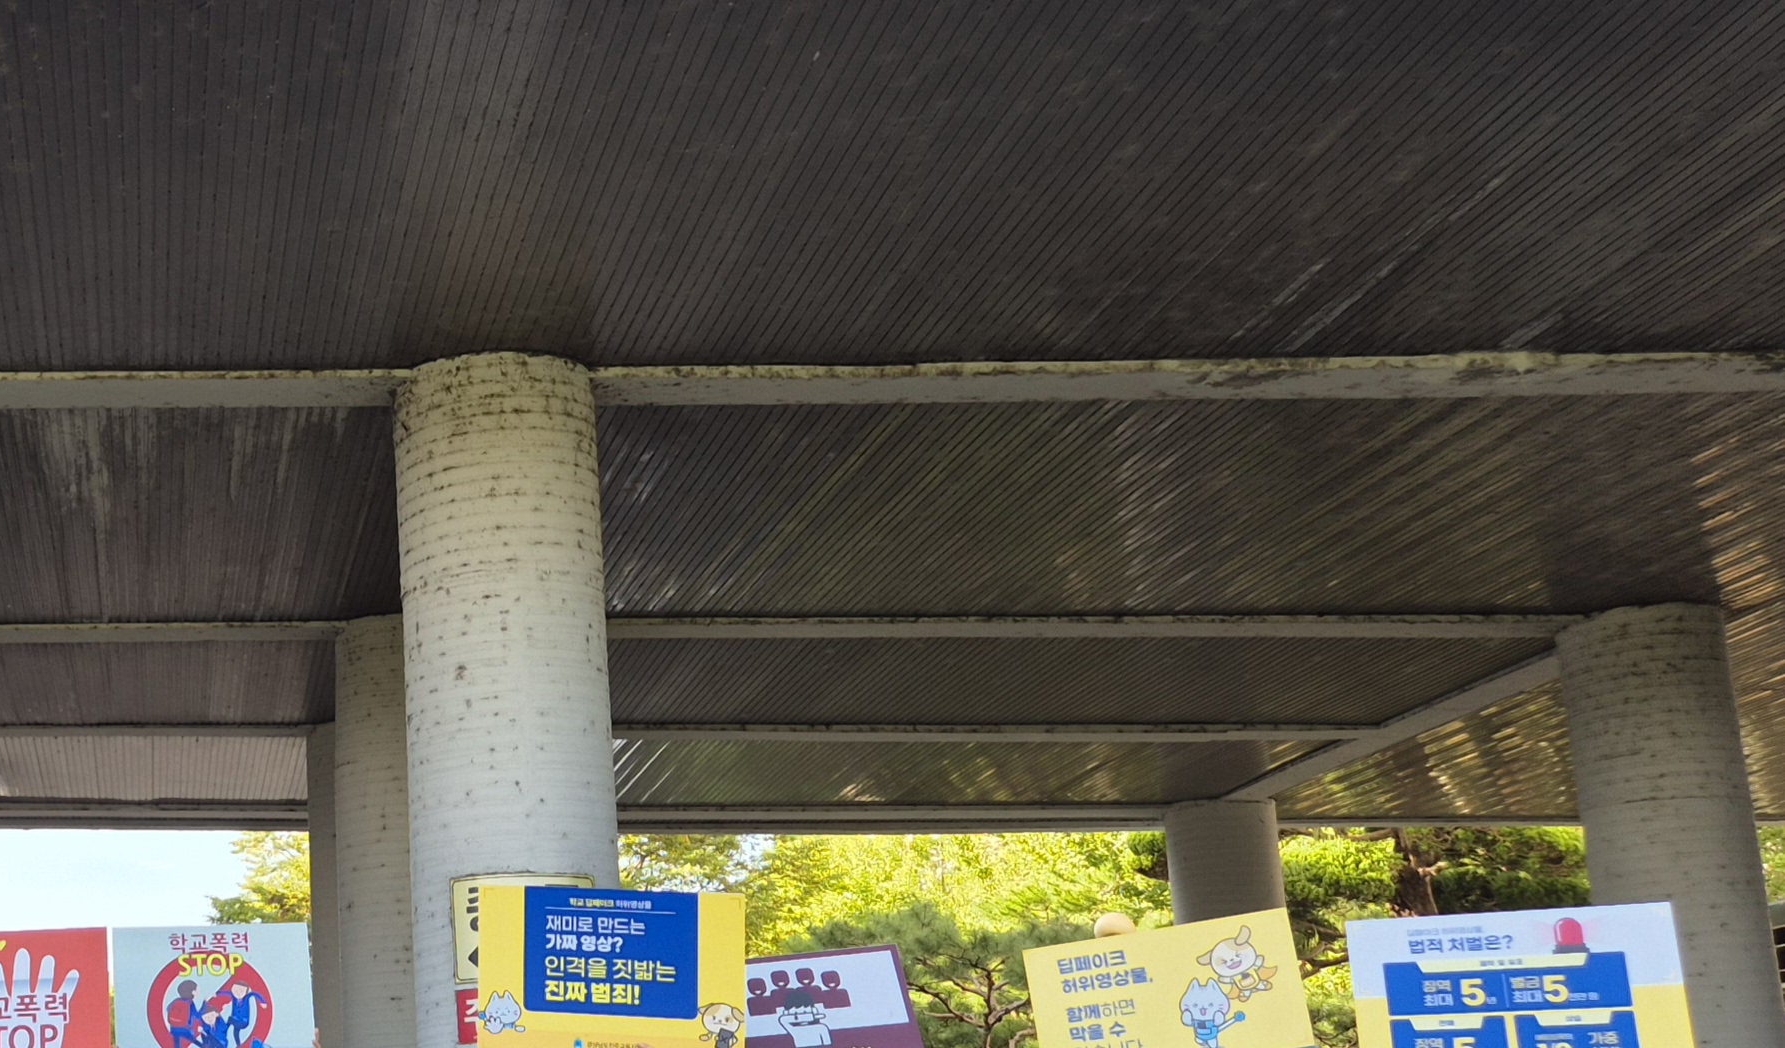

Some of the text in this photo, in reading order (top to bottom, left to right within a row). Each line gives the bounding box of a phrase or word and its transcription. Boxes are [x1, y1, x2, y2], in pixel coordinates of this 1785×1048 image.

[545, 915, 646, 935] 재미로 만드는
[168, 932, 249, 953] 학교폭력
[545, 935, 623, 954] 가짜 영상?
[1408, 935, 1513, 954] 법적 처벌은?
[177, 953, 244, 977] STOP
[545, 956, 676, 983] 인격을 짓밟는
[1057, 950, 1127, 975] 딥페이크
[545, 980, 640, 1005] 진짜 범죄!
[1061, 967, 1154, 994] 허위영상물,
[1422, 980, 1451, 993] 징역
[1423, 994, 1454, 1007] 최대
[1460, 978, 1486, 1006] 5
[1512, 990, 1543, 1004] 최대
[1543, 975, 1569, 1003] 5
[1066, 998, 1136, 1023] 함께하면
[1069, 1021, 1126, 1042] 막을 수
